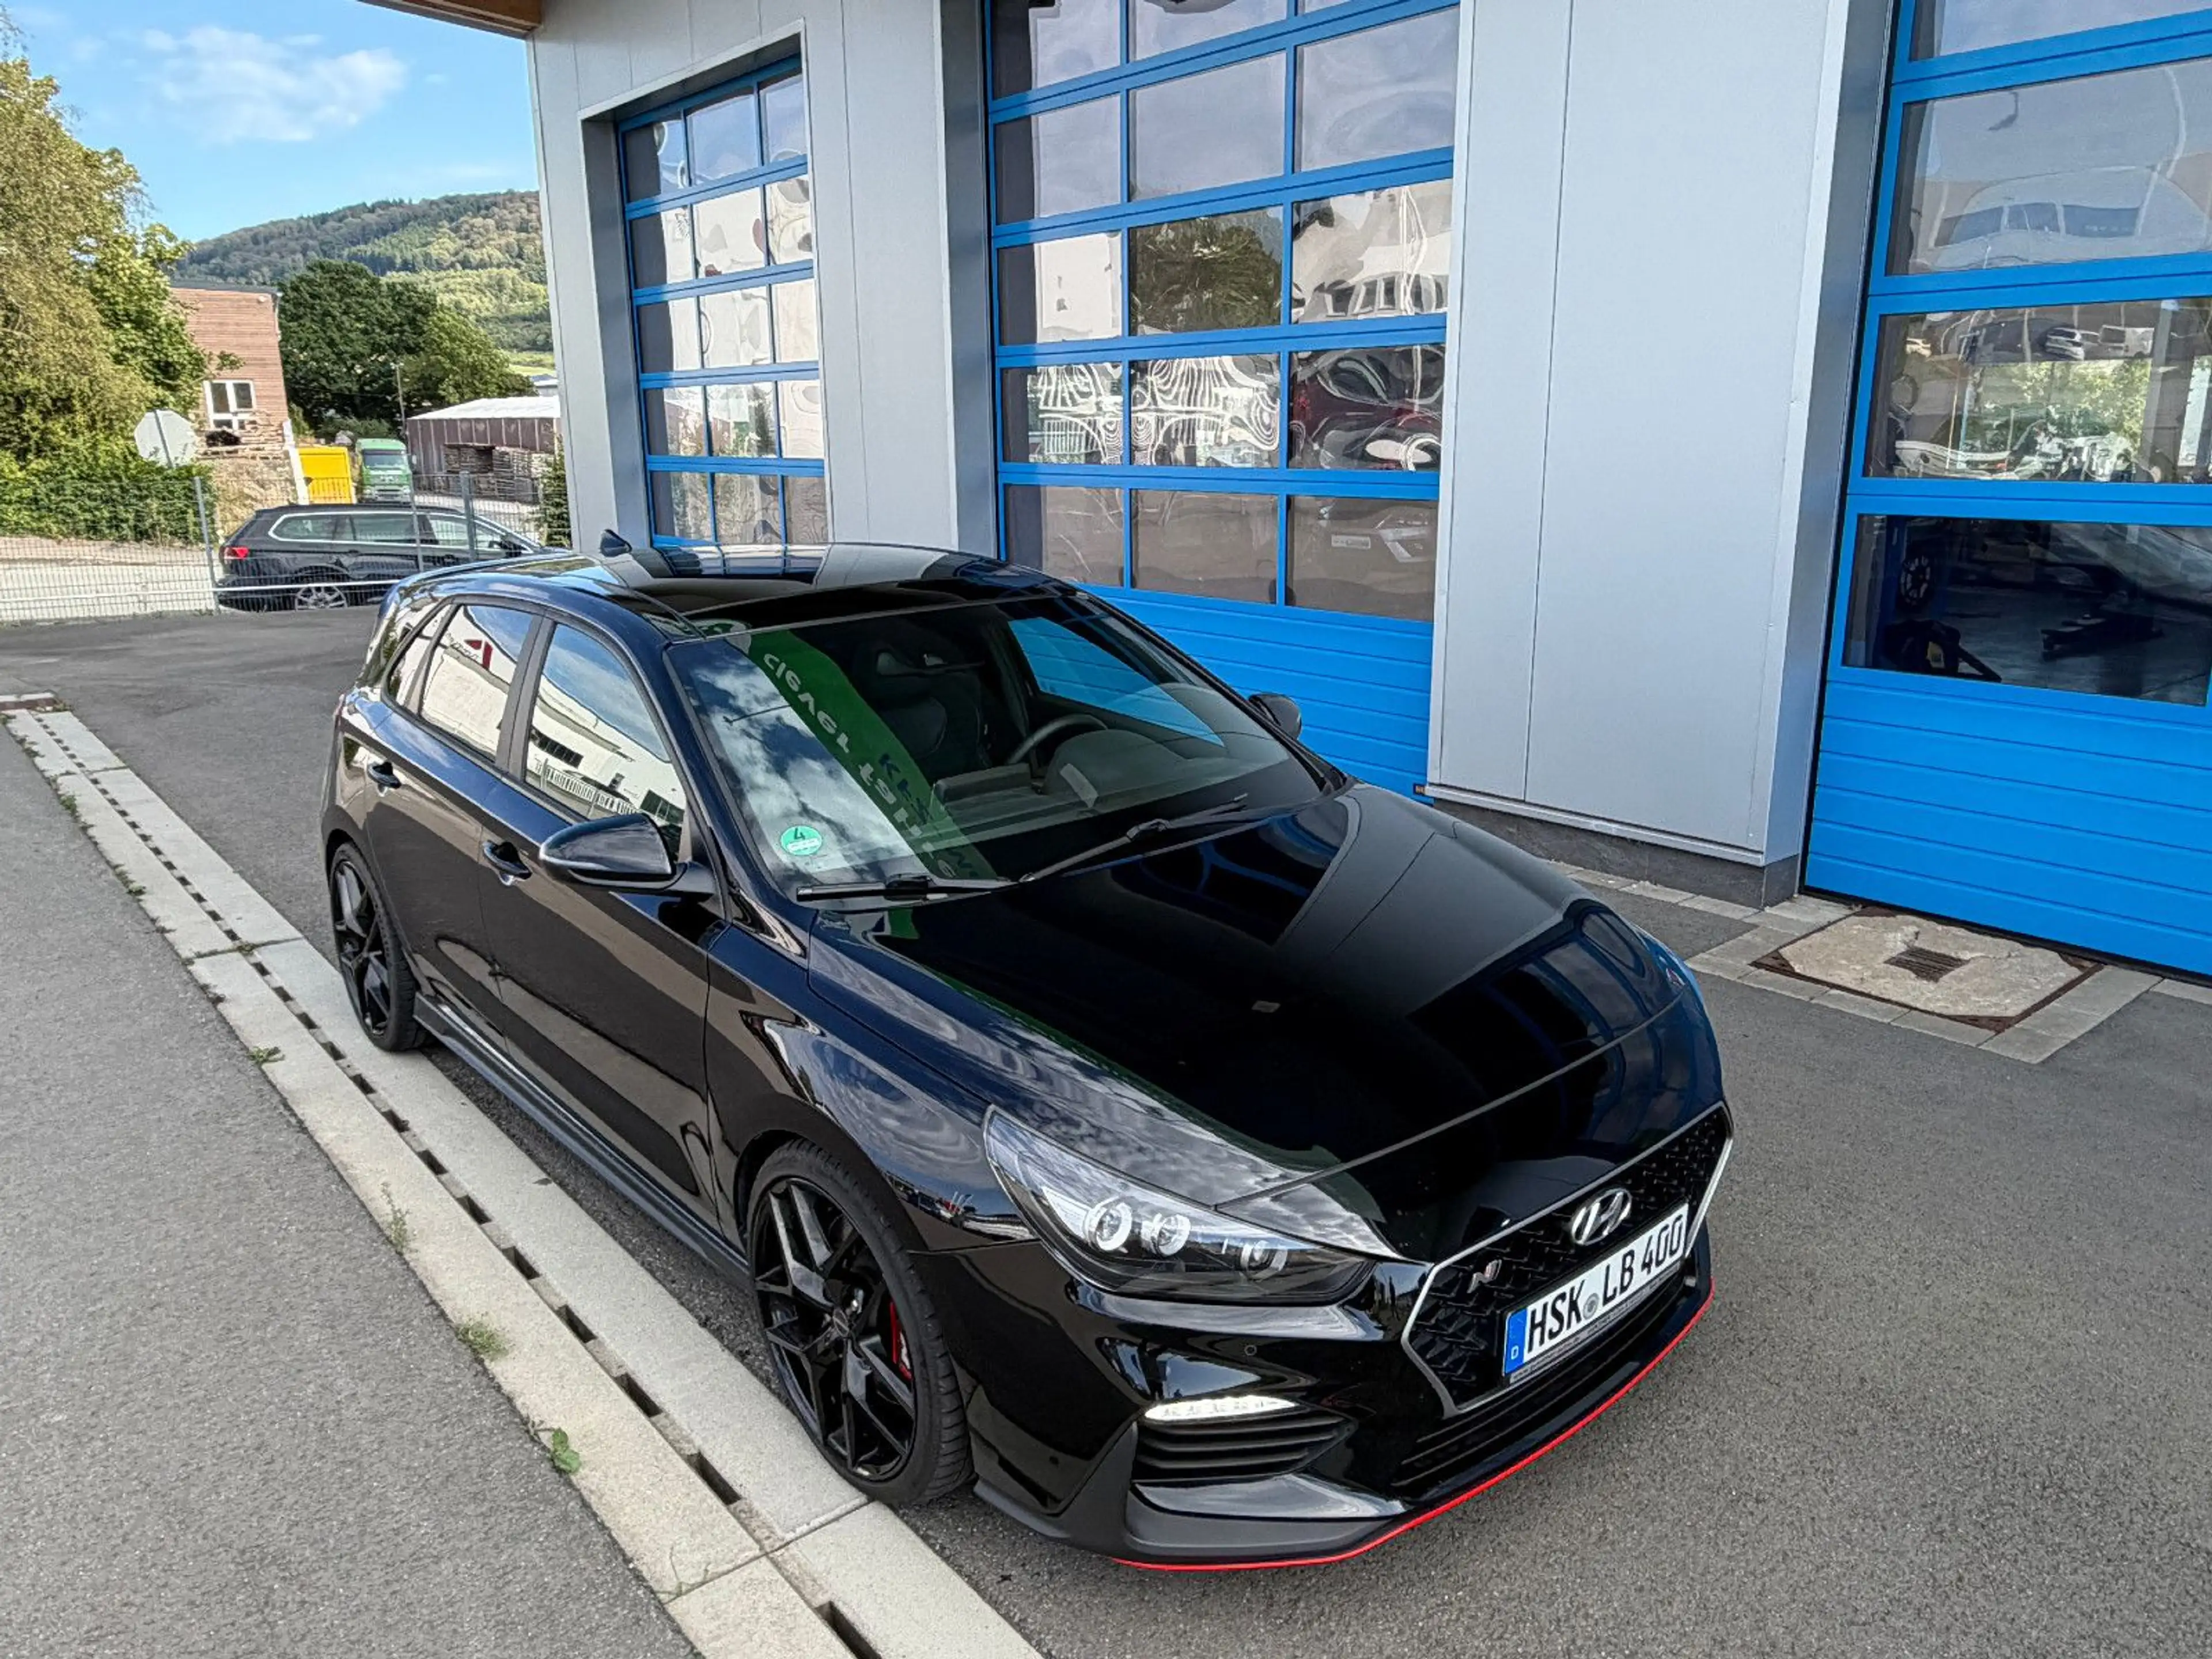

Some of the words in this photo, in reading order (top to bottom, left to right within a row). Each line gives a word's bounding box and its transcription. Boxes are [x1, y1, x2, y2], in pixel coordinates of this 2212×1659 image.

[793, 827, 806, 840] 4
[1528, 1279, 1585, 1354] HSK
[1602, 1249, 1635, 1307] LB
[1641, 1214, 1683, 1275] 400
[1510, 1345, 1519, 1360] D
